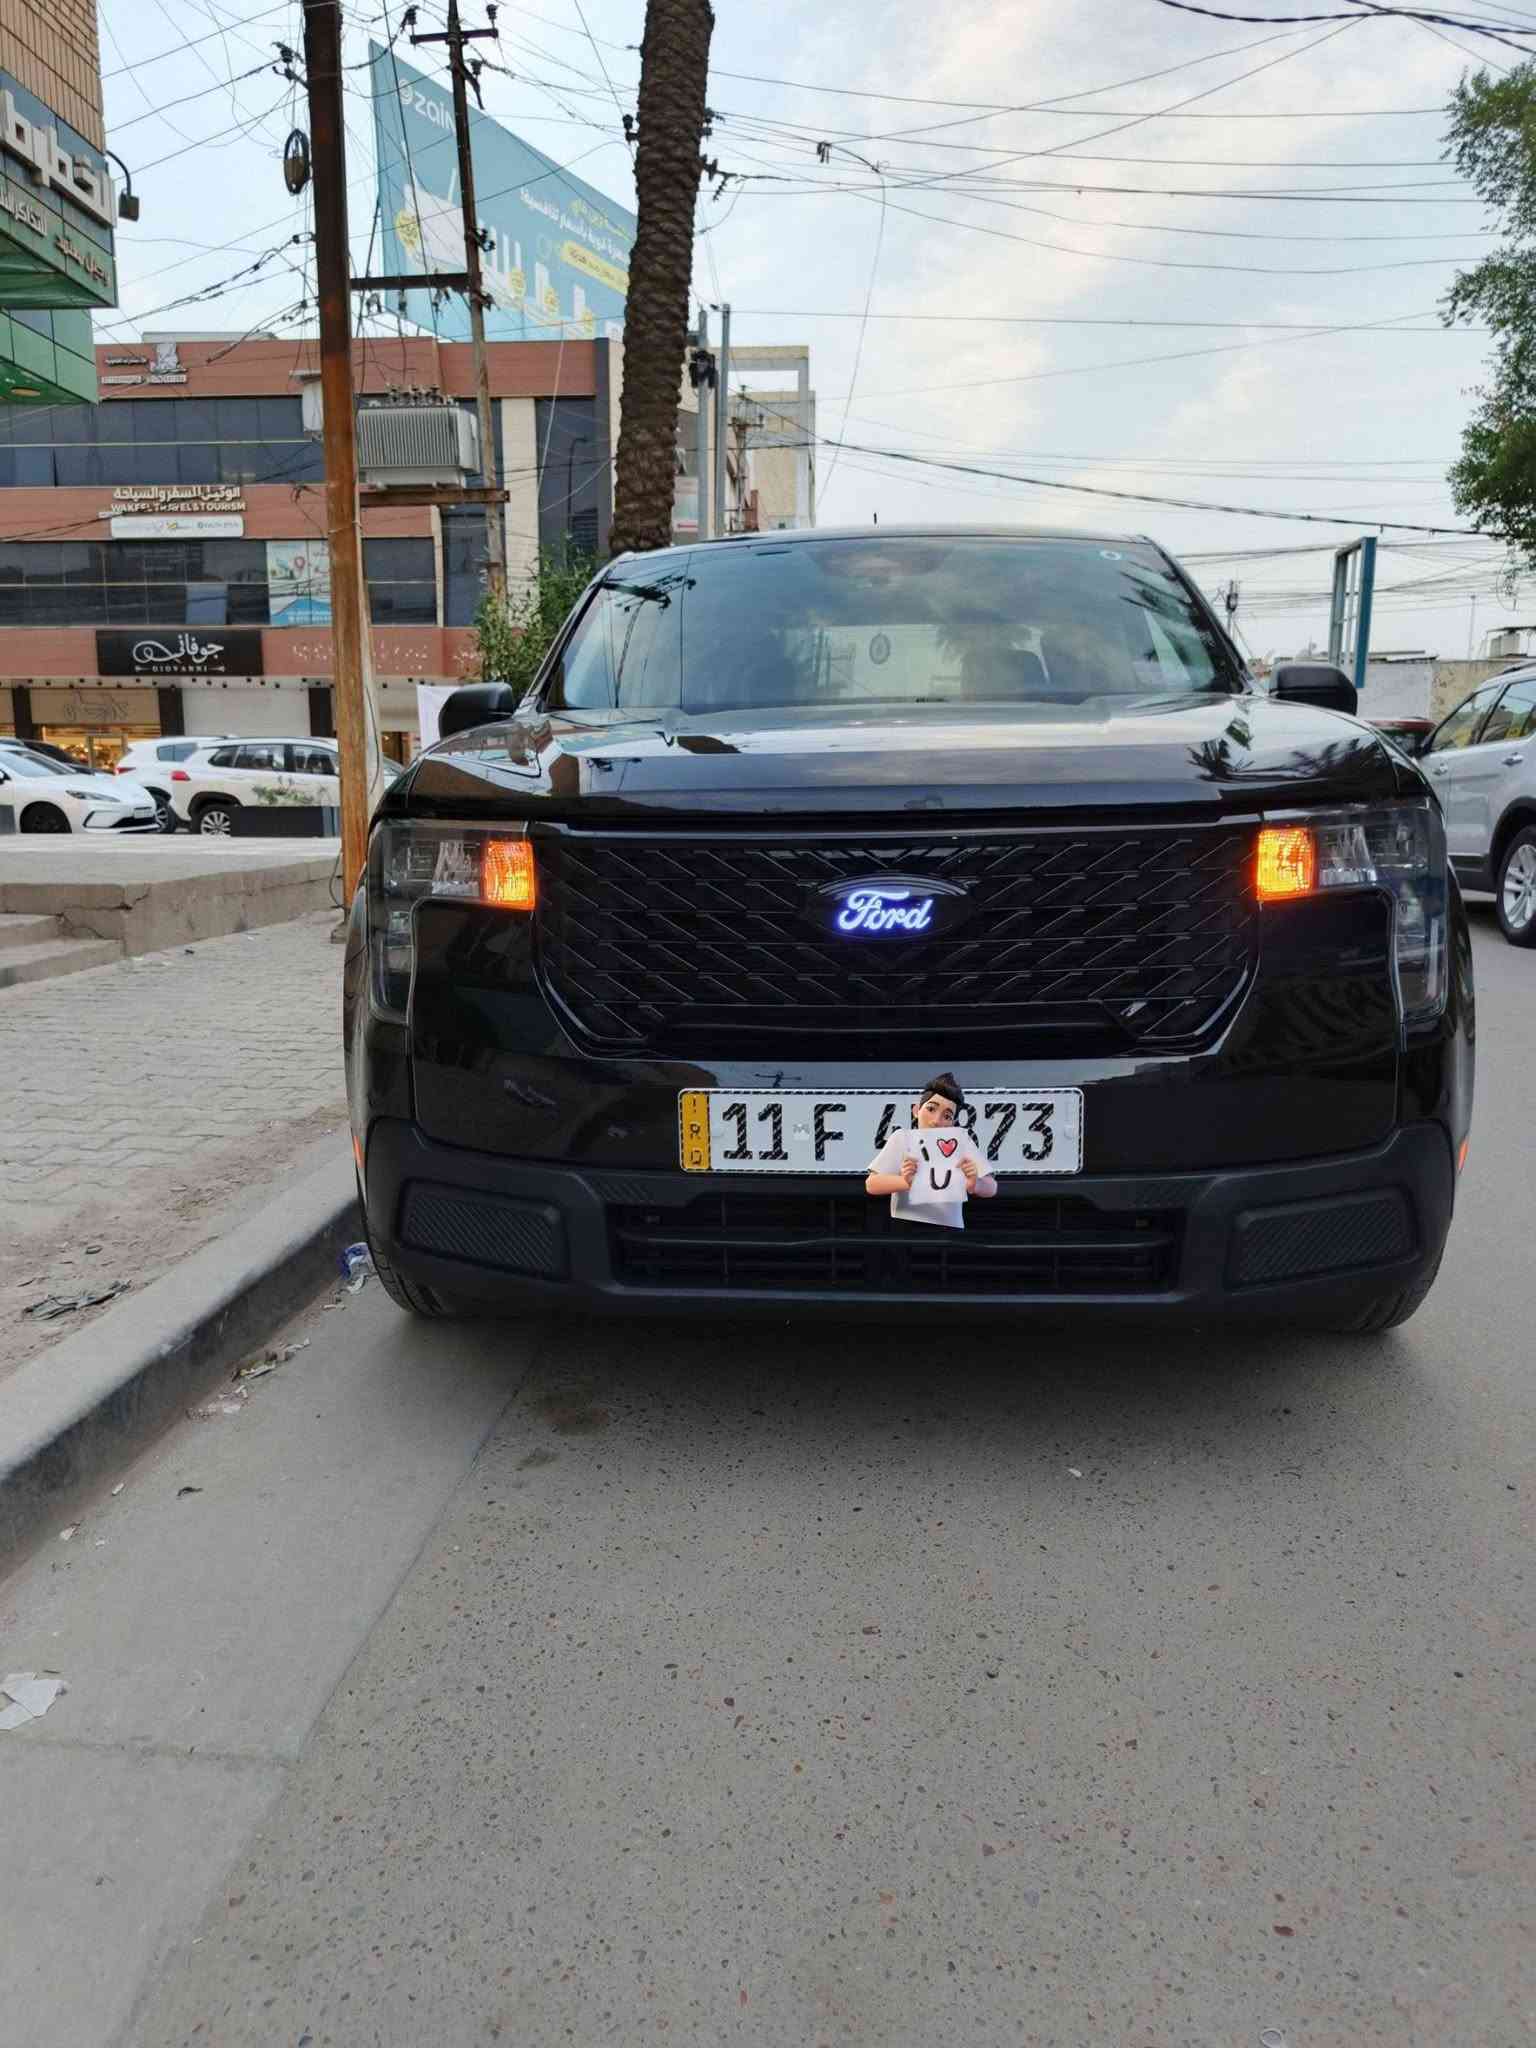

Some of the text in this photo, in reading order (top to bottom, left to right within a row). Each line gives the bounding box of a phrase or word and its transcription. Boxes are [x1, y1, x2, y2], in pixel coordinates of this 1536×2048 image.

[838, 890, 933, 930] Ford
[722, 1102, 788, 1161] 11
[814, 1103, 846, 1161] F
